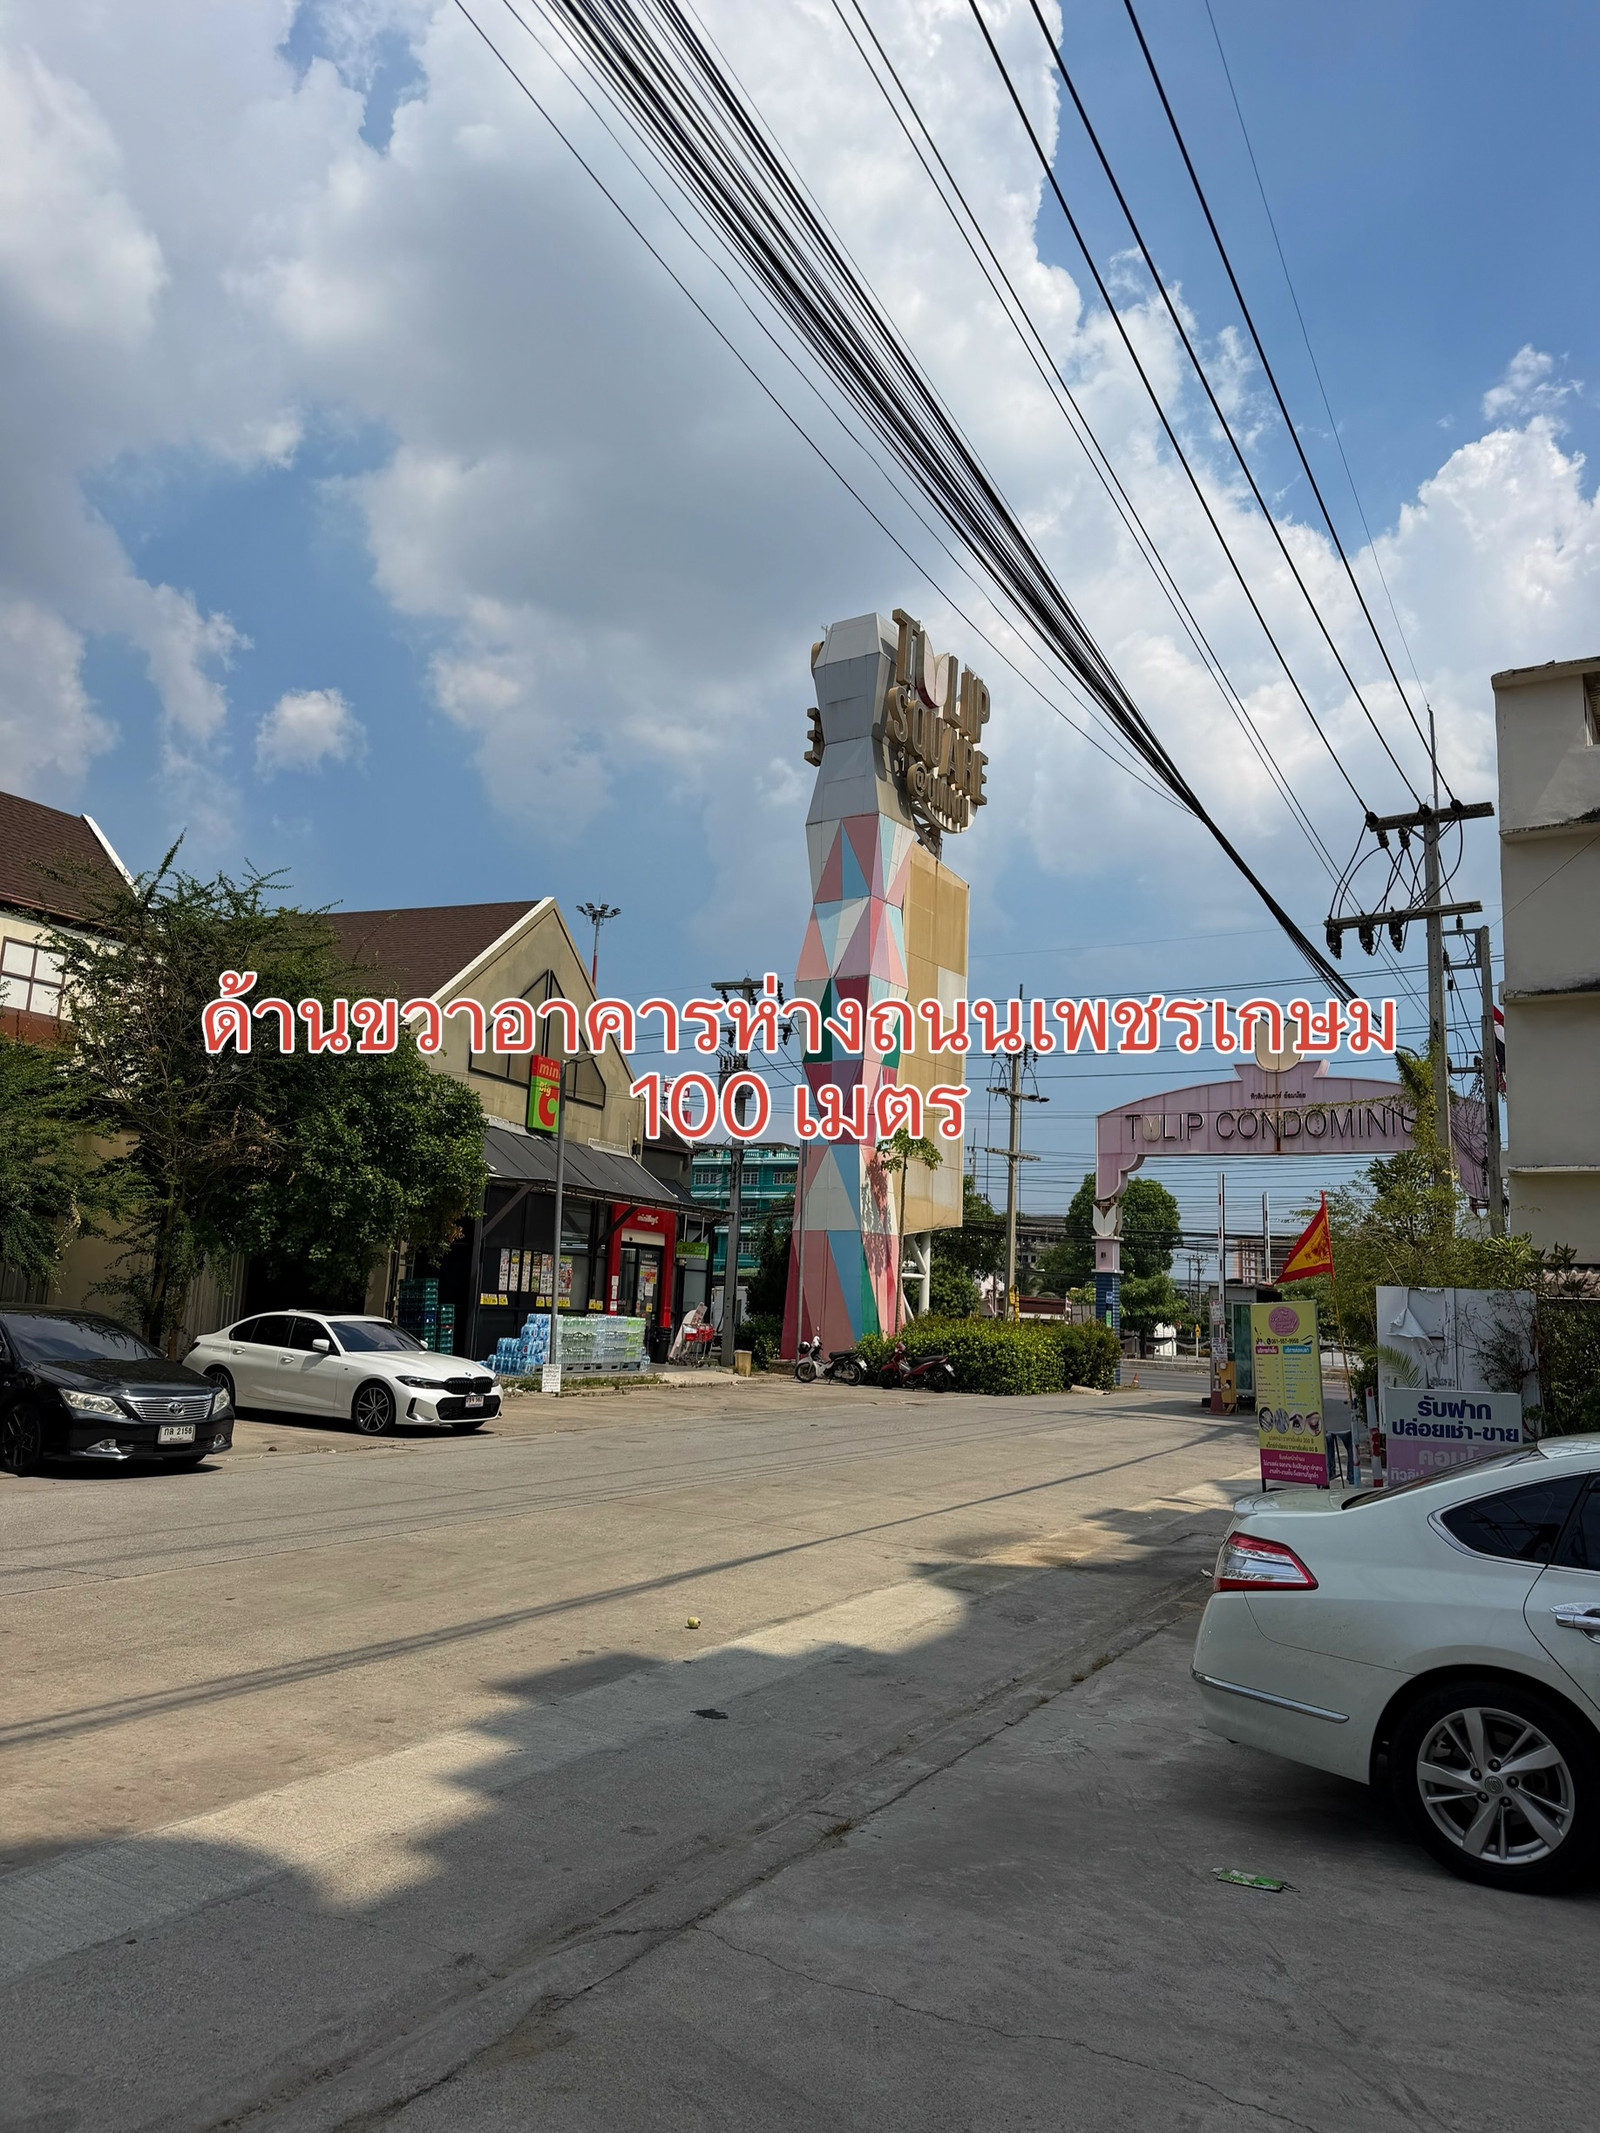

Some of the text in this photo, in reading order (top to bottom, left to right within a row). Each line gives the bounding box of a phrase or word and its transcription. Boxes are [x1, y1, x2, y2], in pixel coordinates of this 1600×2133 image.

[887, 686, 989, 806] SQUARE
[539, 1061, 560, 1079] min
[1125, 1107, 1414, 1142] TULIP CONDOMINIU
[1417, 1395, 1492, 1420] รับฝาก
[1392, 1418, 1519, 1443] ปล่อยเช่า-ขาย
